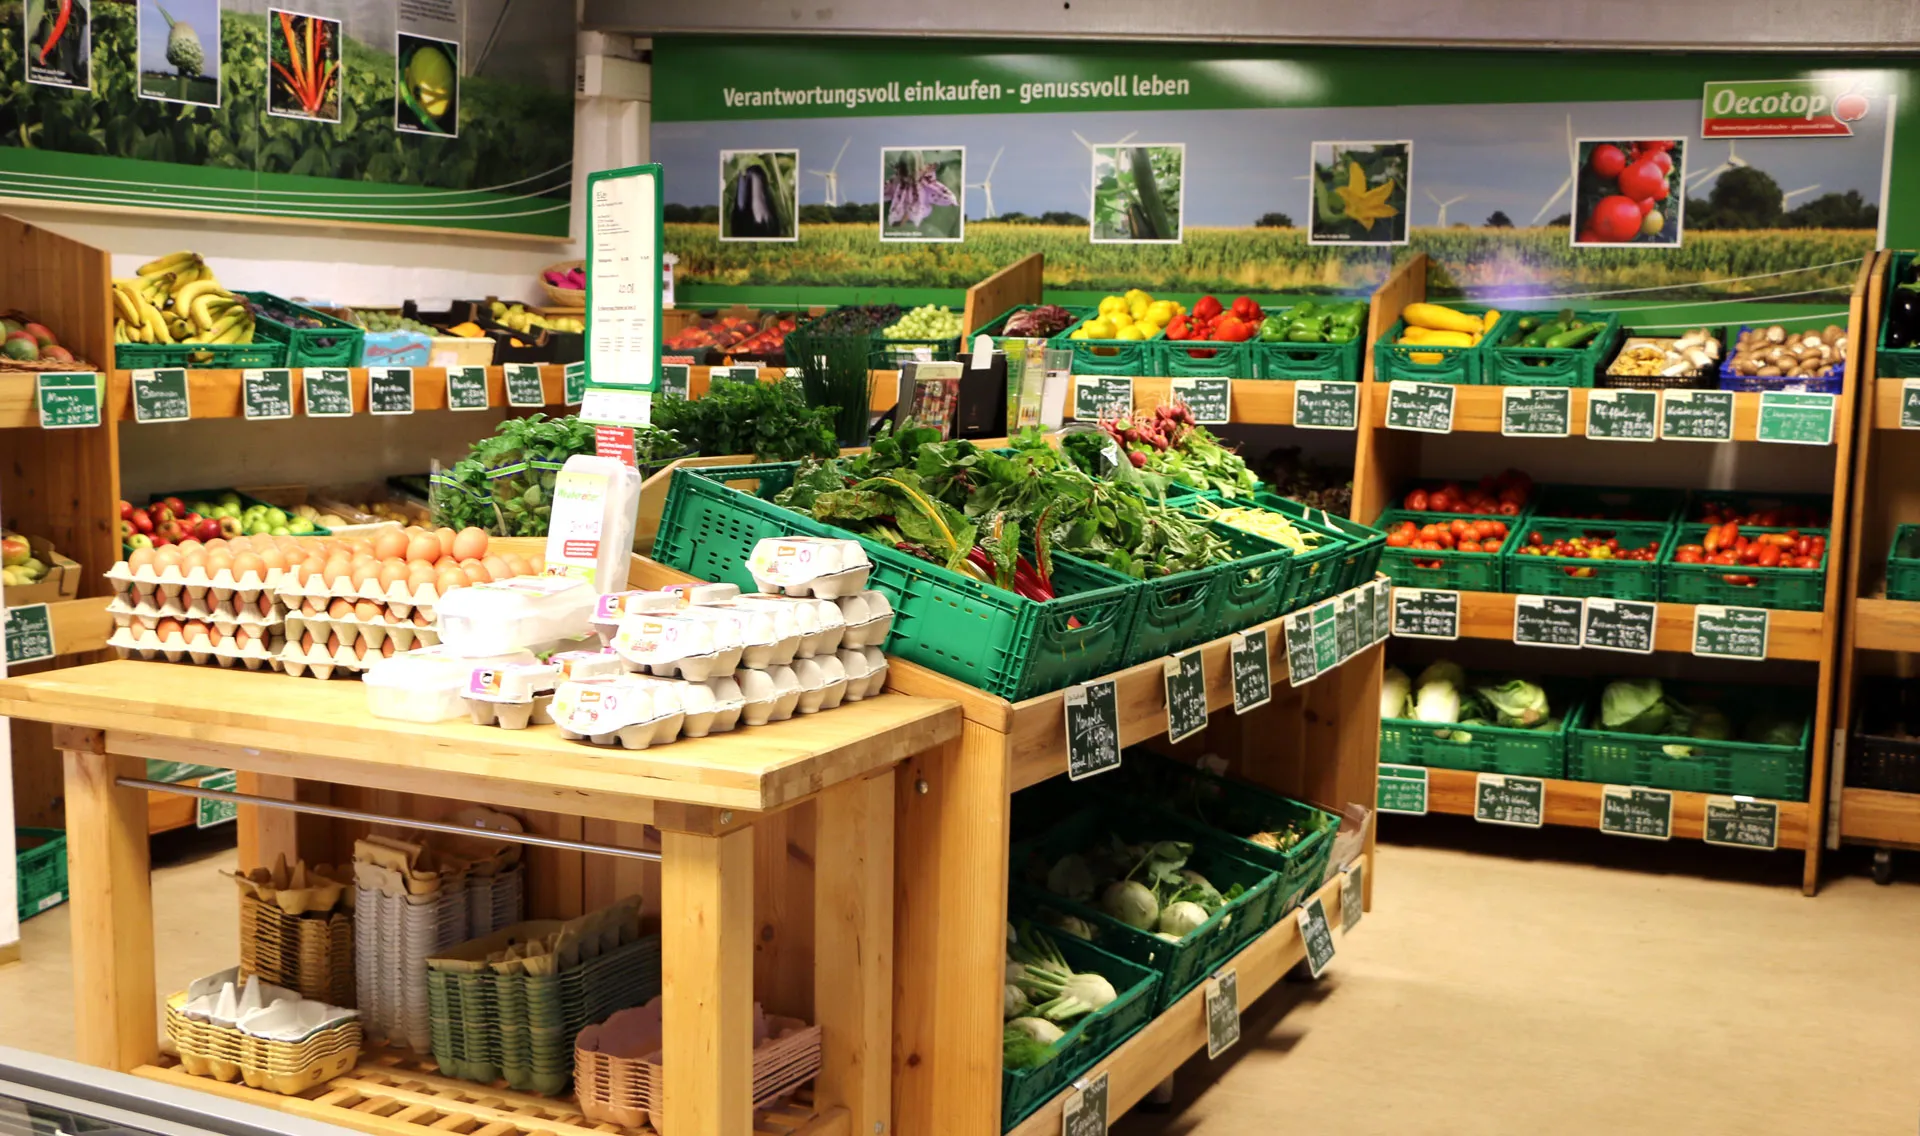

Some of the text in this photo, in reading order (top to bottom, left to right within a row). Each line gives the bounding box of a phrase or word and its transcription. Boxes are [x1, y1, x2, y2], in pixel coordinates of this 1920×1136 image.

[723, 81, 900, 109] Verantwortungsvoll
[904, 79, 1001, 103] einkaufen
[1019, 76, 1128, 104] genussvoll
[1133, 74, 1190, 98] leben
[1712, 89, 1828, 121] Oecotop
